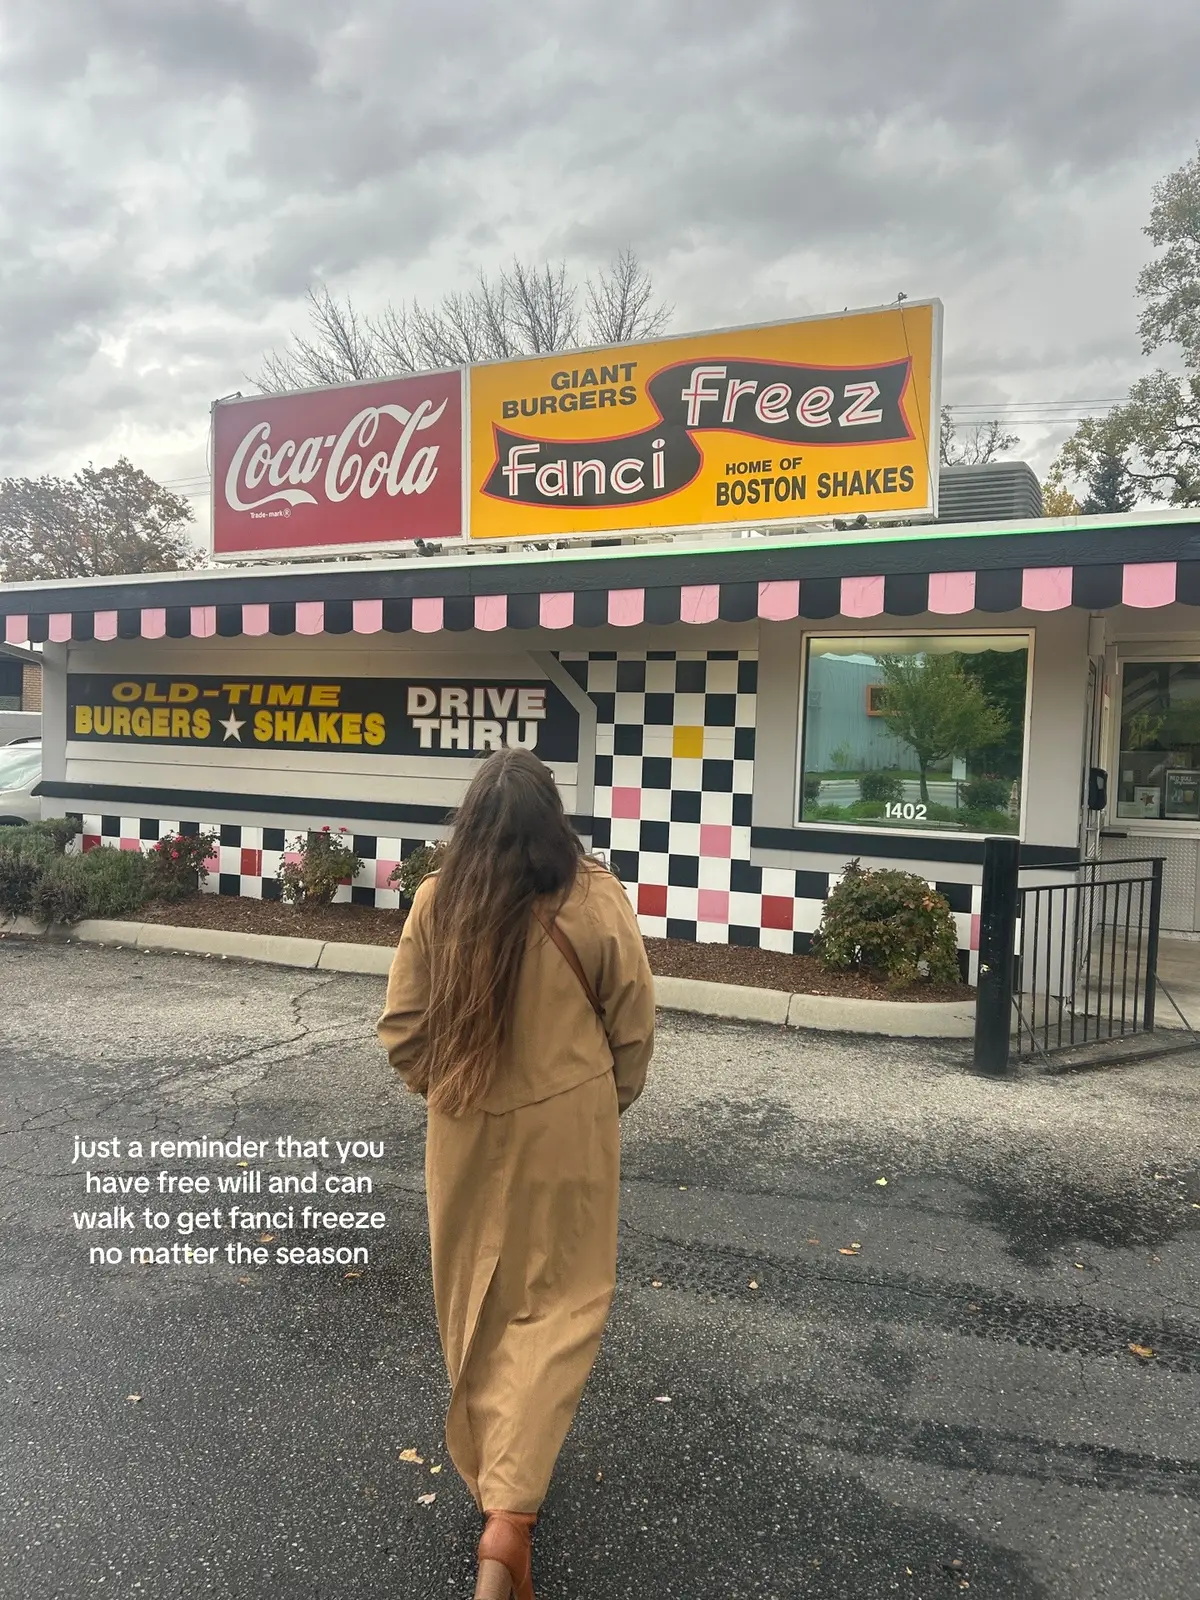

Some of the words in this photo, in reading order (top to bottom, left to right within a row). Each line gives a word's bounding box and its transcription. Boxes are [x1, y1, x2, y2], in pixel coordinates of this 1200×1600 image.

[551, 362, 638, 391] GIANT
[502, 385, 638, 419] BURGERS
[681, 366, 884, 427] freez
[225, 397, 449, 512] Coca-Cola
[502, 438, 666, 497] fanci
[725, 459, 773, 475] HOME
[779, 456, 804, 471] OF
[716, 475, 807, 507] BOSTON
[817, 465, 915, 499] SHAKES
[111, 682, 342, 708] OLD-TIME
[406, 685, 547, 720] DRIVE
[75, 705, 212, 740] BURGERS
[253, 709, 386, 747] SHAKES
[412, 717, 539, 752] THRU
[884, 801, 928, 821] 1402
